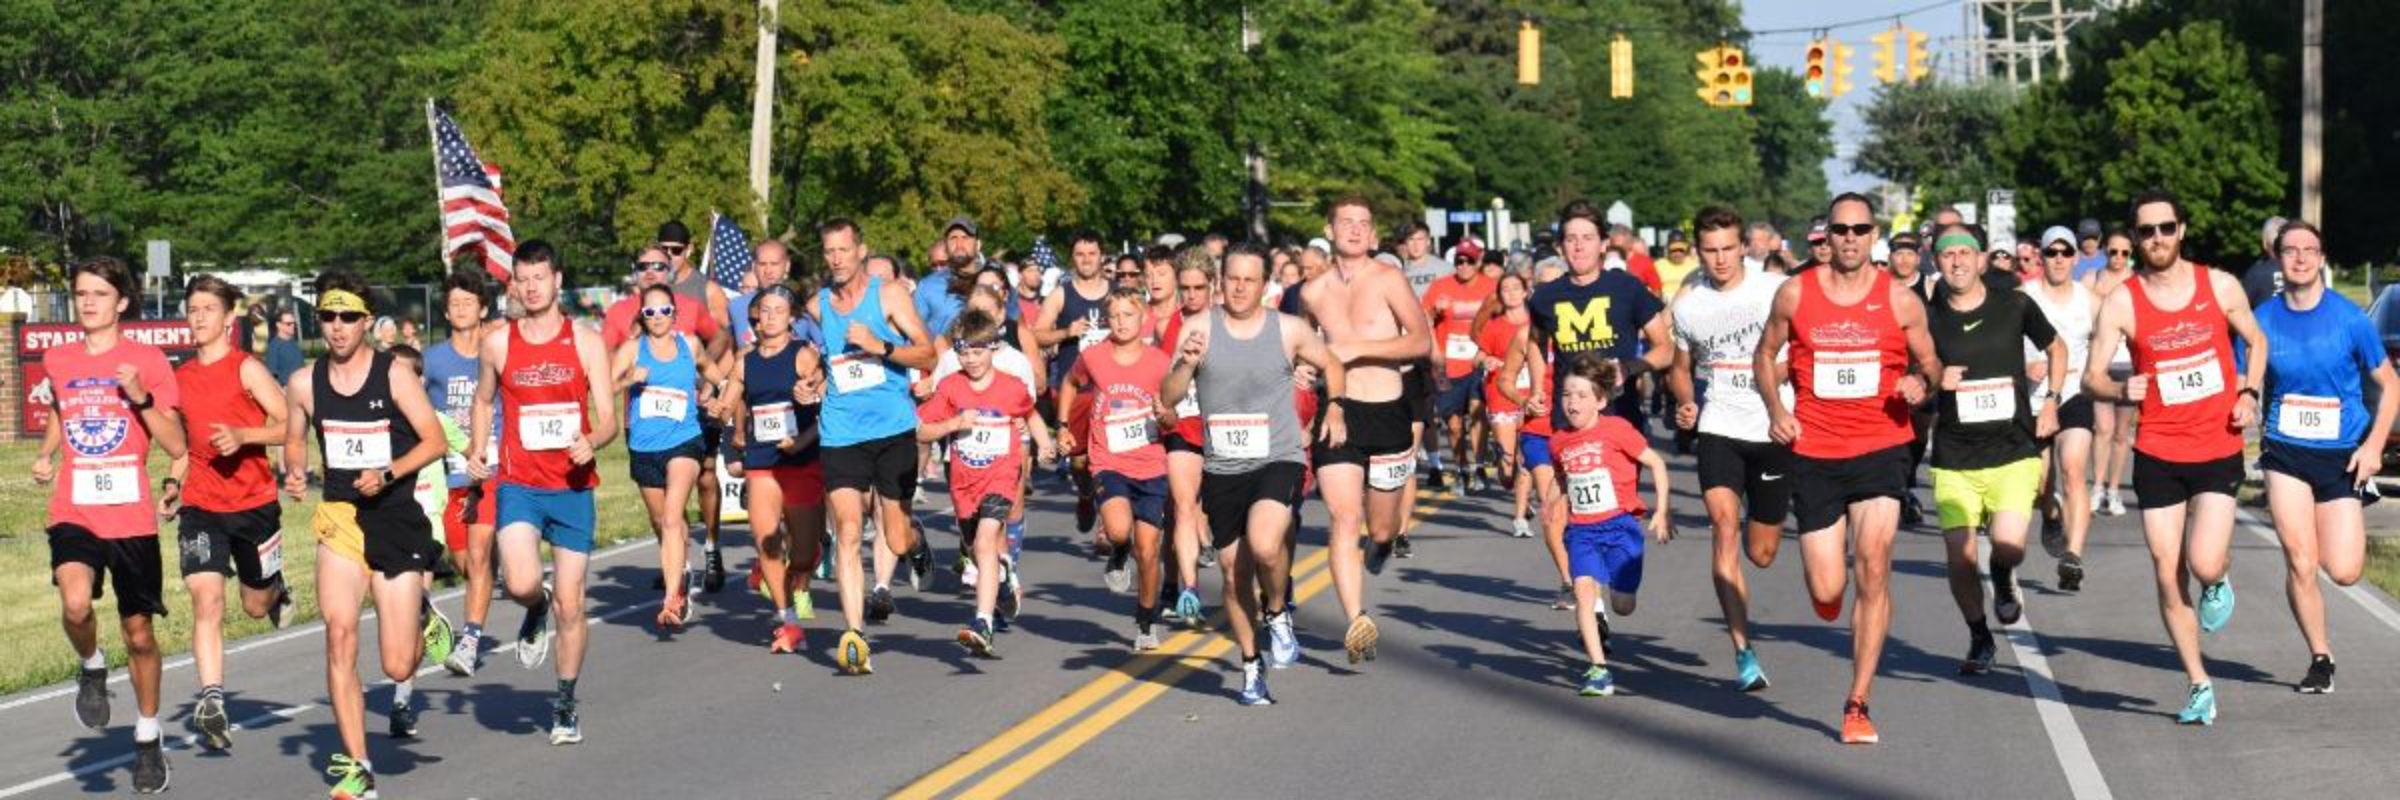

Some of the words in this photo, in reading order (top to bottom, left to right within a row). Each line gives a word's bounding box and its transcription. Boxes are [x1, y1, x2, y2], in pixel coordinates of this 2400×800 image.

[1554, 296, 1613, 344] M
[1837, 367, 1857, 385] 66
[2178, 371, 2204, 390] 143
[539, 419, 563, 436] 142
[2299, 411, 2321, 427] 105
[975, 430, 991, 444] 47
[1226, 430, 1249, 447] 132
[345, 437, 364, 456] 24
[1573, 483, 1602, 505] 217
